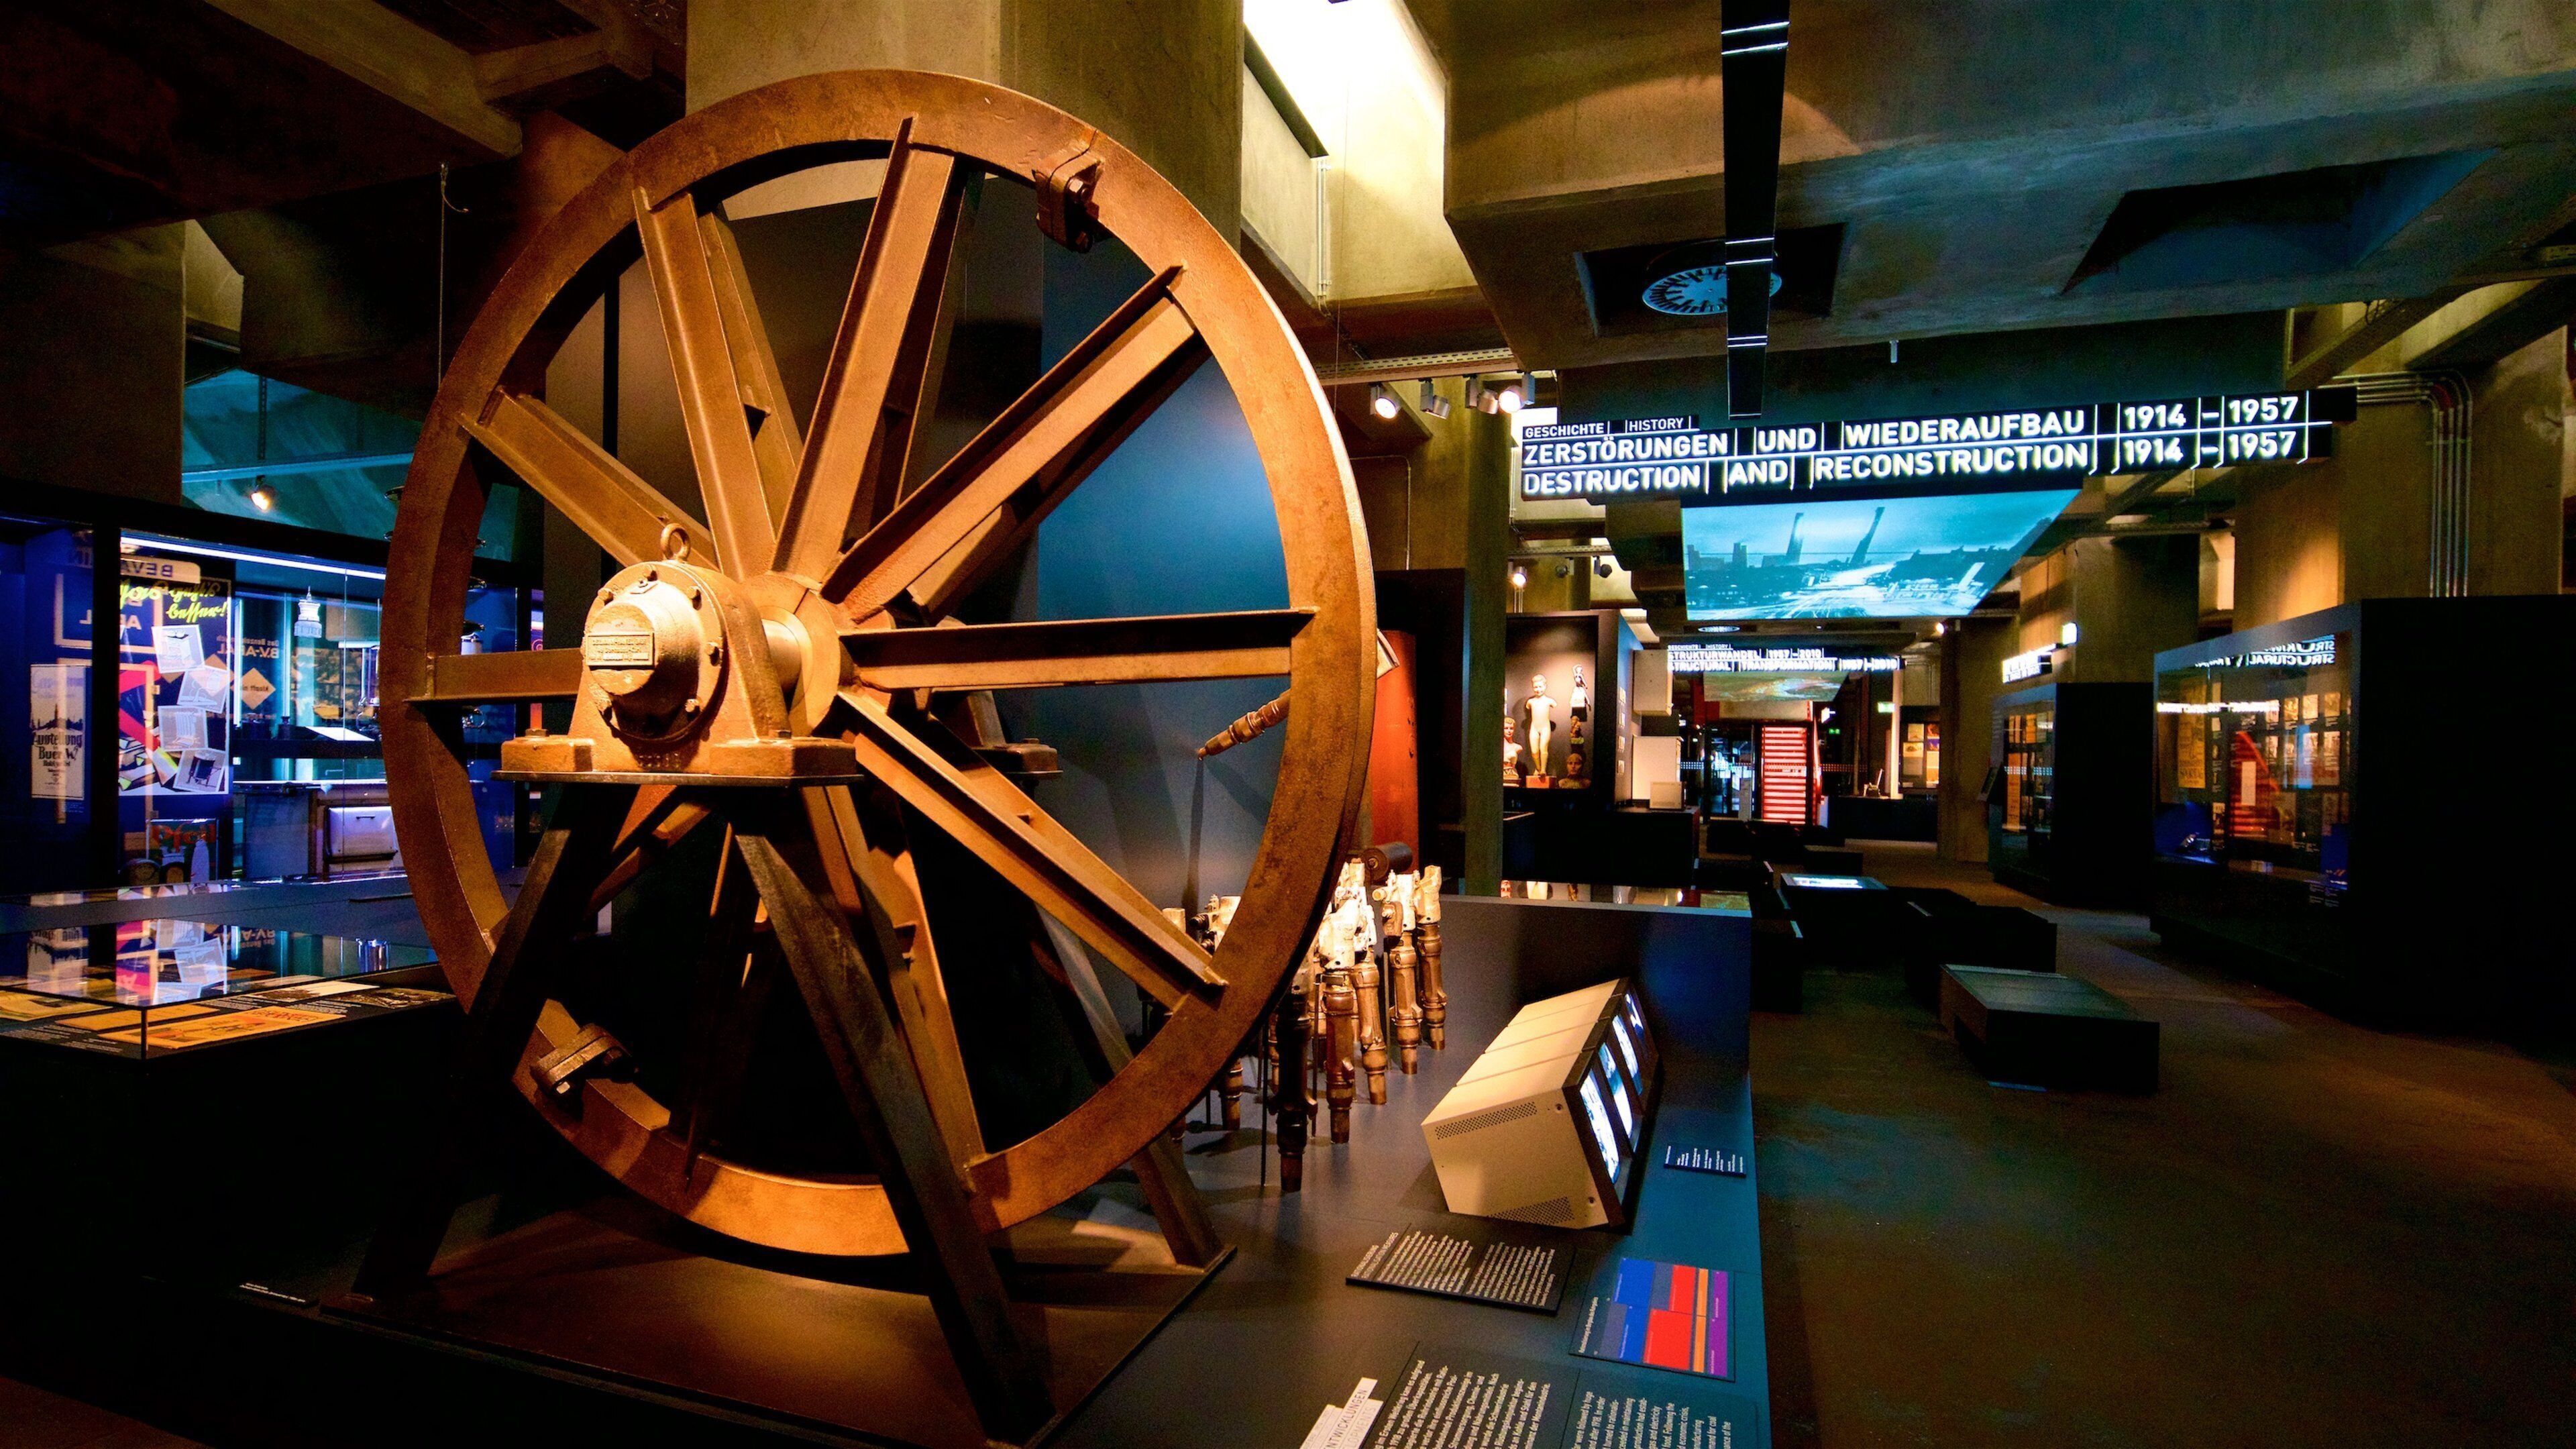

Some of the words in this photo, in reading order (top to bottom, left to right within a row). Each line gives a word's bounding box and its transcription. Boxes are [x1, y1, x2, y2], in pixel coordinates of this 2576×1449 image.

[1524, 433, 1728, 466] ZERSTÖRUNGEN
[1758, 427, 1817, 452] UND
[1845, 409, 2085, 447] WIEDERAUFBAU
[2124, 403, 2187, 430] 1914
[2229, 396, 2299, 424] 1957
[1525, 423, 1605, 438] GESCHICHTE
[1629, 417, 1684, 431] HISTORY
[1525, 464, 1701, 495] DESTRUCTION
[1728, 459, 1789, 484] AND
[1814, 441, 2088, 482] RECONSTRUCTION
[2123, 437, 2184, 465] 1914
[2229, 431, 2297, 460] 1957
[1668, 651, 1760, 660] STRUKTURWANDEL
[1768, 649, 1790, 658] 1957
[1799, 649, 1822, 658] 2010
[1668, 661, 1731, 672] STRUCTURAL
[1741, 660, 1833, 671] TRANSFORMATION
[1324, 1389, 1366, 1449] NTWICKLUNGEN
